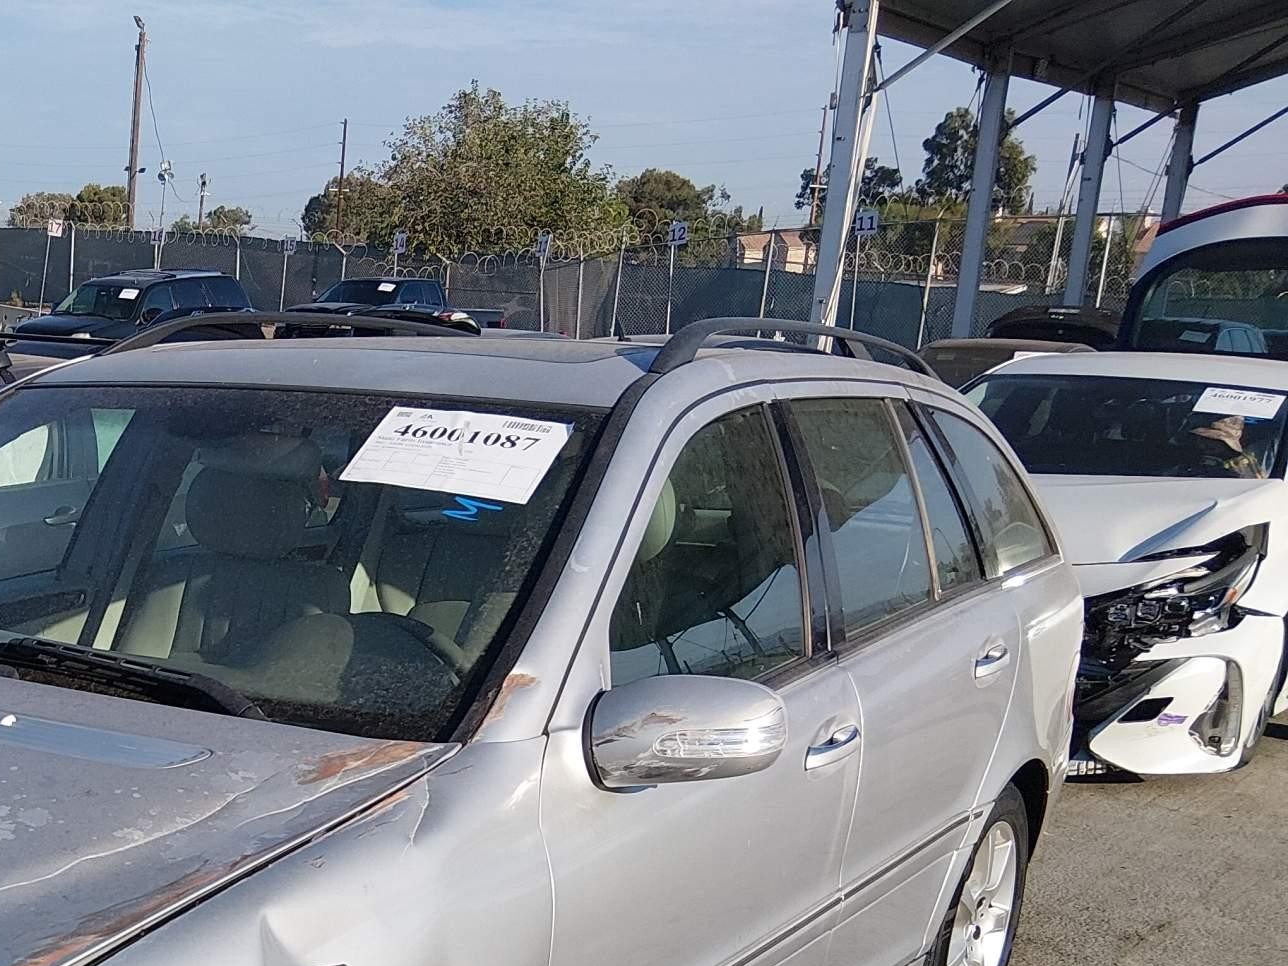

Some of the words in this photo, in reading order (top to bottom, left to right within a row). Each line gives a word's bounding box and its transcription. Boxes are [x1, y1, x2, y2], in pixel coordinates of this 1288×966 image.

[48, 220, 62, 234] 17
[856, 216, 876, 232] 11
[669, 226, 687, 242] 12
[393, 423, 541, 451] 46001087
